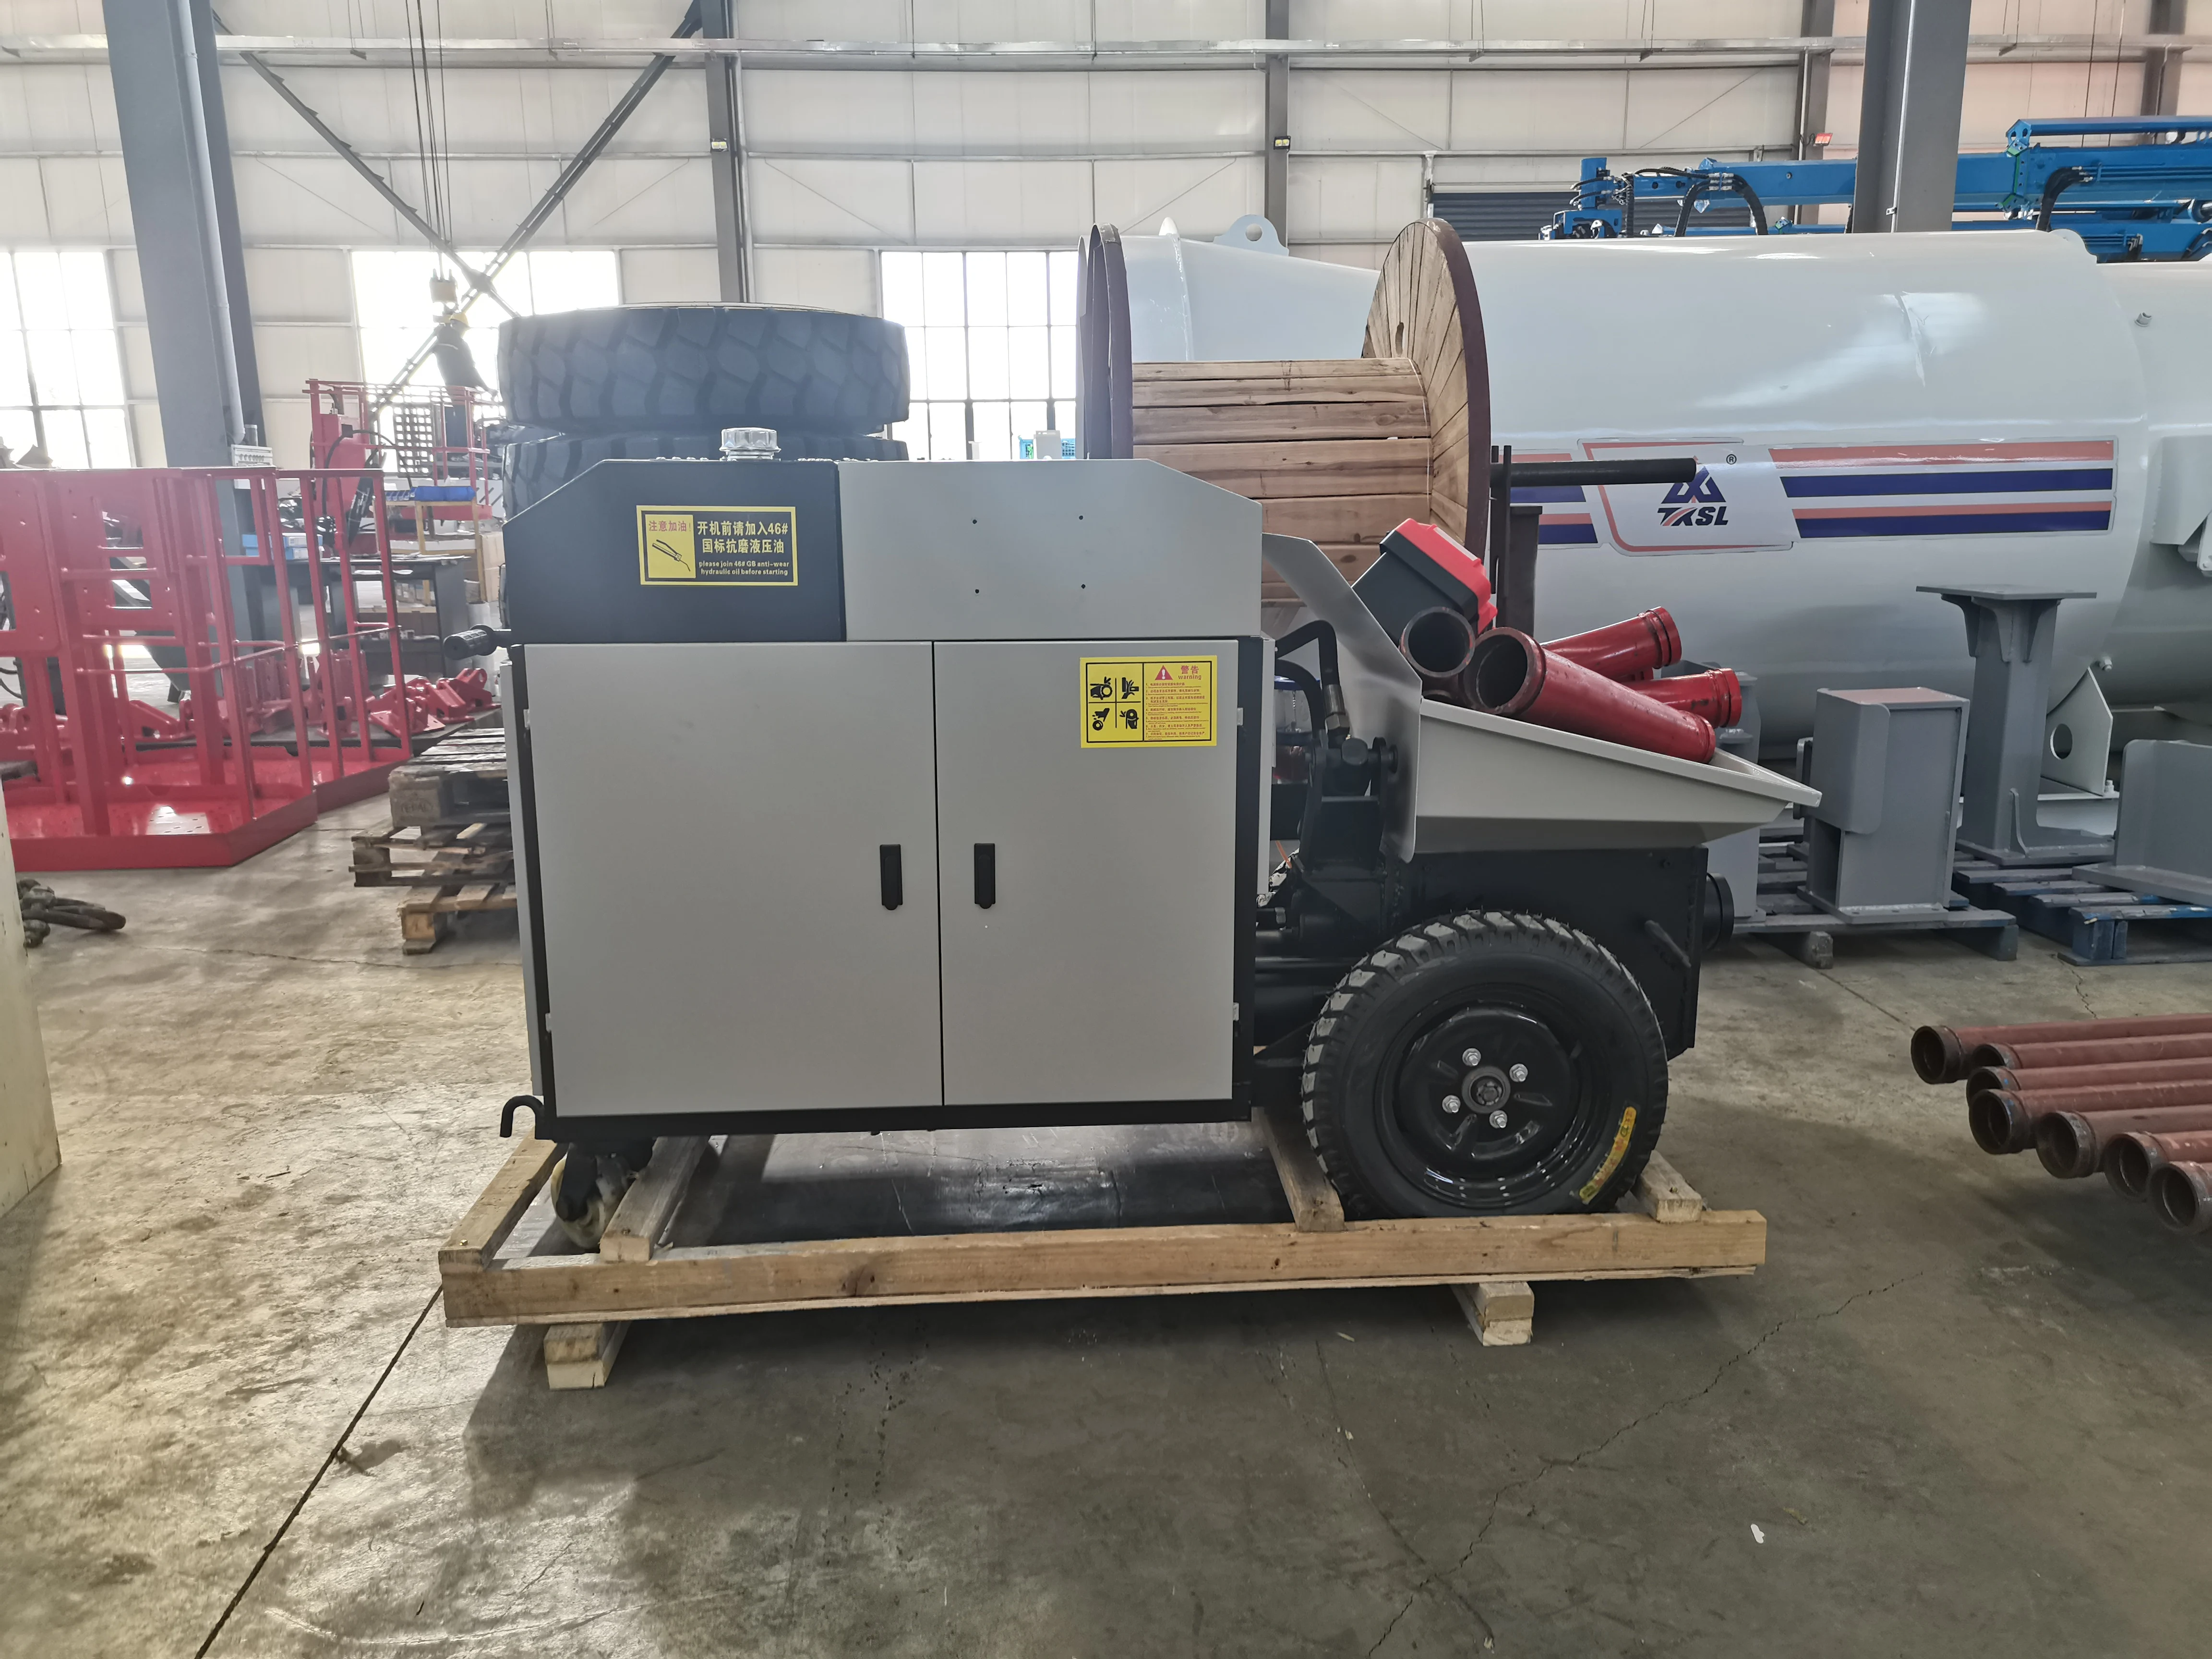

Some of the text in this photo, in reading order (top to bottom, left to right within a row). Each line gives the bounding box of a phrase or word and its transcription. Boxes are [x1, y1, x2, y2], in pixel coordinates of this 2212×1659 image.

[697, 520, 788, 536] 开机前请加入46#
[702, 539, 784, 553] 国标抗磨液压油
[1181, 665, 1199, 674] 警告
